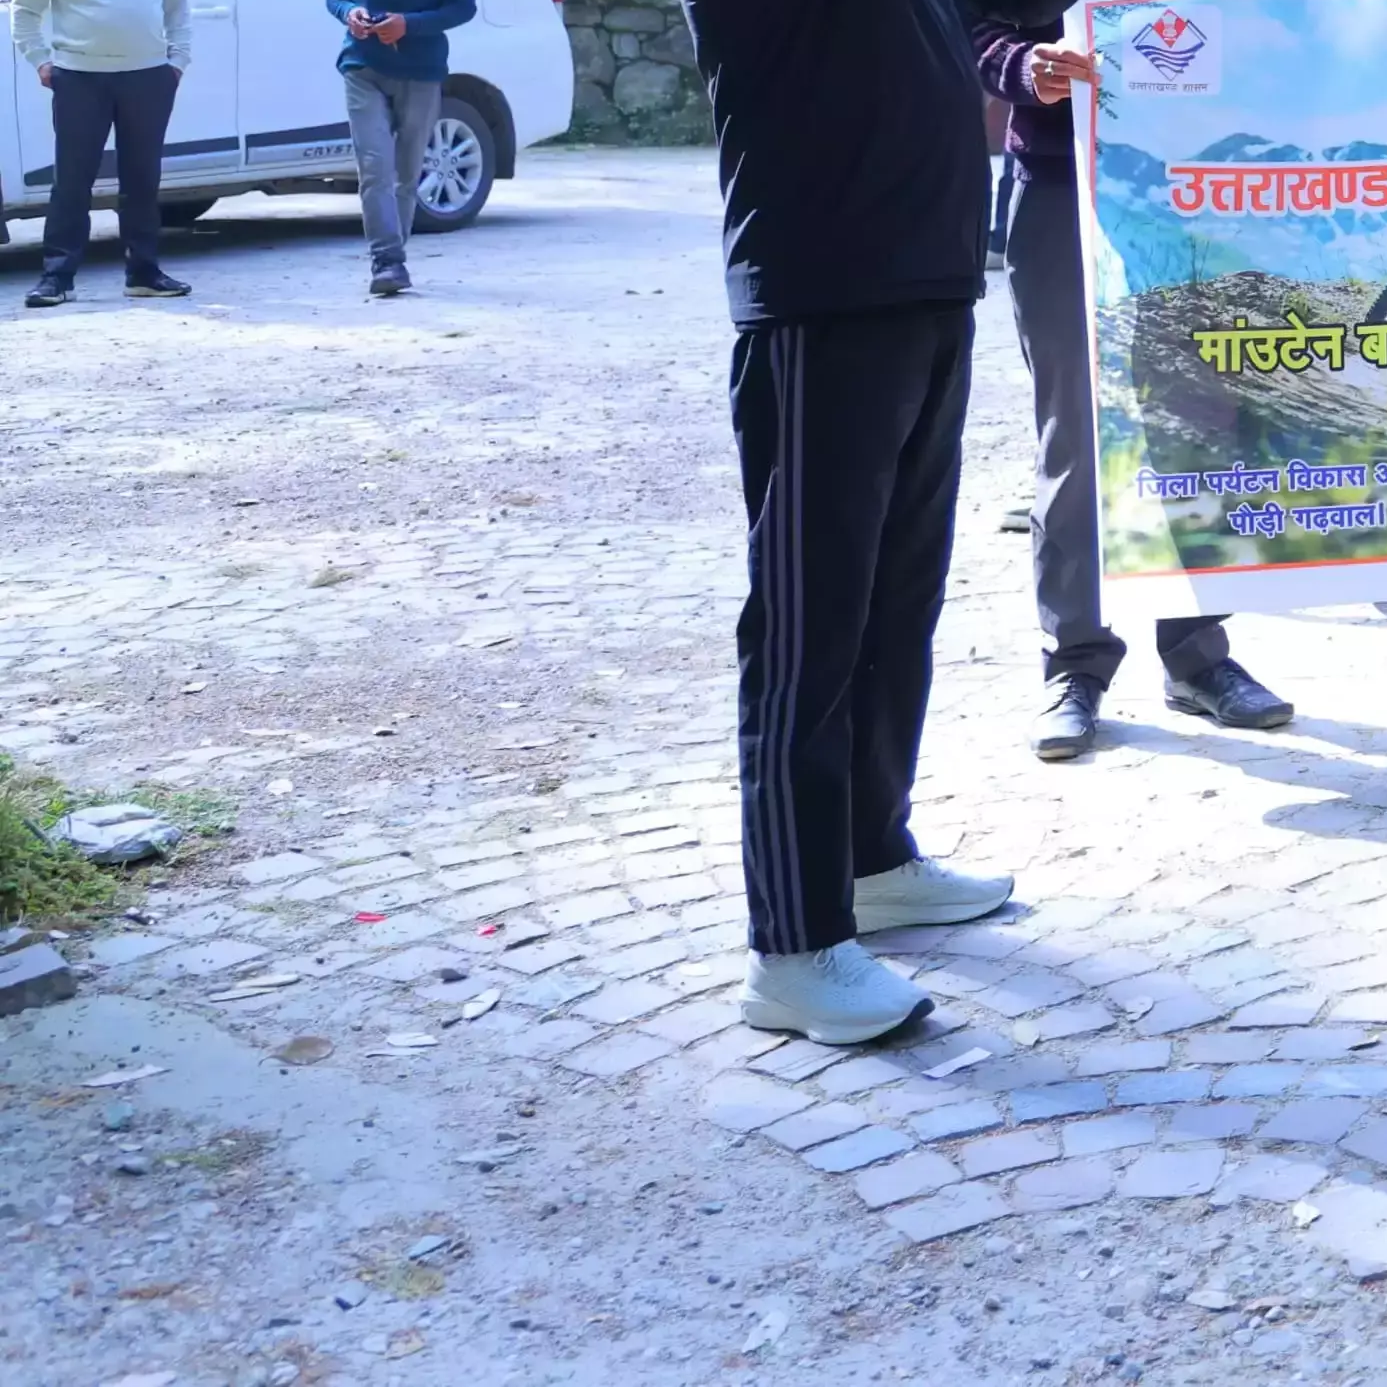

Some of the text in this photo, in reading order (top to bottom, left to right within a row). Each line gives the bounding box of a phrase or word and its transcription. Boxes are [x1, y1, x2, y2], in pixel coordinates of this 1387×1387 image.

[1193, 314, 1345, 373] मांउटेन
[1136, 466, 1199, 499] जिला
[1205, 461, 1280, 496] पर्यटन
[1286, 458, 1367, 491] विकास
[1228, 501, 1284, 539] पौड़ी
